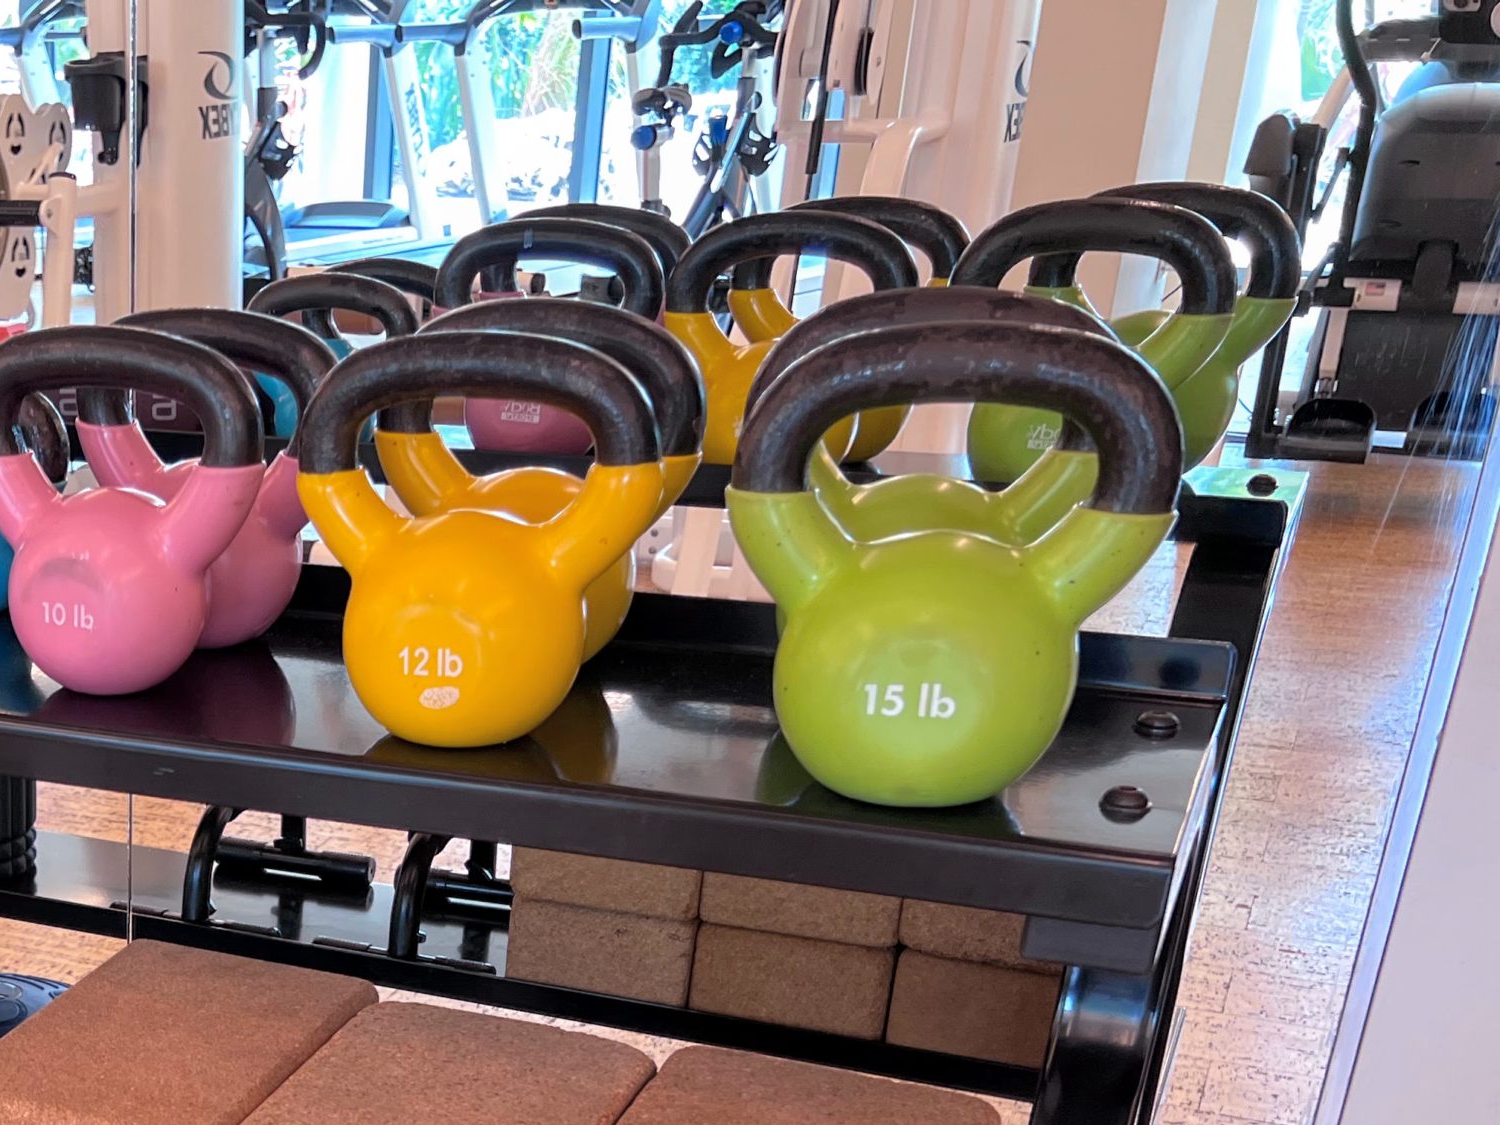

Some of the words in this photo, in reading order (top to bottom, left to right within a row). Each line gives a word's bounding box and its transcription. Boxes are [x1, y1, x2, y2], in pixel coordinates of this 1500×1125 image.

[42, 601, 67, 626] 10
[73, 603, 94, 630] lb
[398, 646, 430, 677] 12
[437, 647, 464, 678] lb
[863, 683, 905, 717] 15
[918, 682, 957, 719] lb
